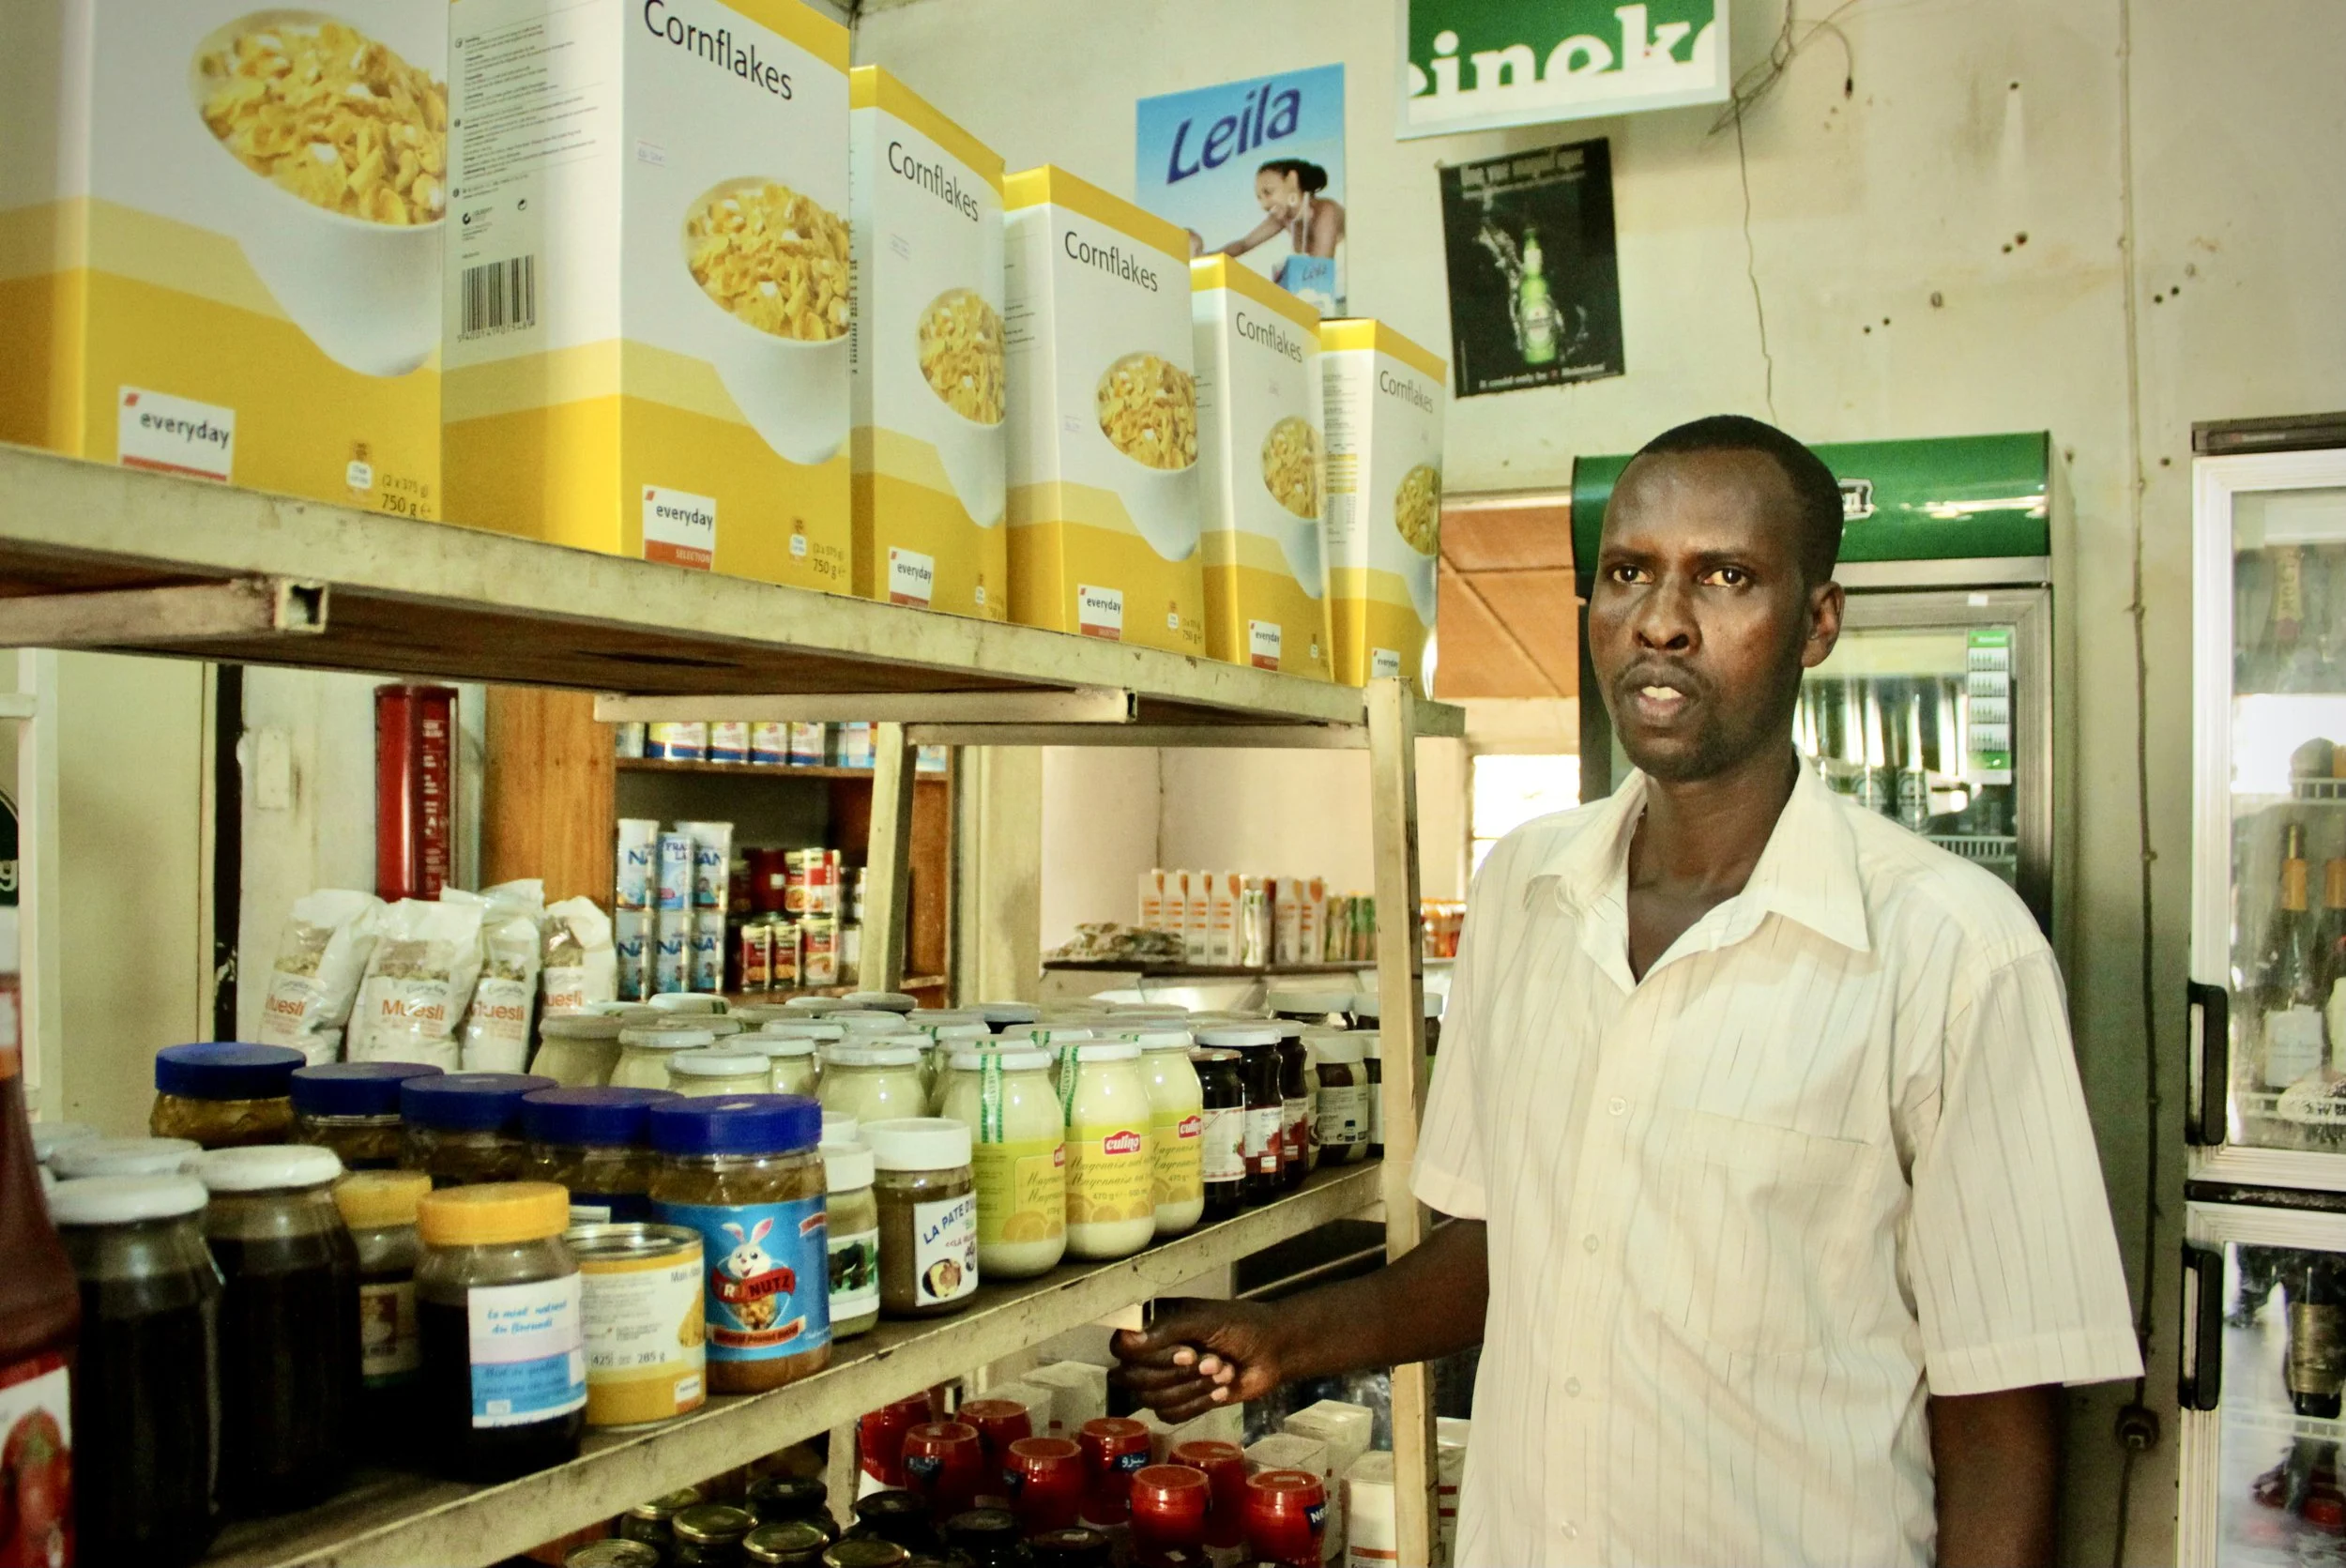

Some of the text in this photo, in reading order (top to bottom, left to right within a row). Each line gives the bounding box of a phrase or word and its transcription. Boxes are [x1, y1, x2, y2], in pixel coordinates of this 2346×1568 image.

[645, 0, 792, 100] Cornflakes
[1166, 83, 1302, 185] Leila
[888, 141, 979, 222] Cornflakes
[1064, 230, 1159, 292] Cornflakes
[1237, 311, 1302, 363] Cornflakes
[1379, 370, 1434, 414] Cornflakes
[140, 410, 231, 450] everyday
[382, 493, 406, 513] 750
[656, 504, 714, 531] everyday
[676, 548, 711, 563] SELECTION
[813, 557, 830, 574] 750
[897, 561, 932, 586] everyday
[1087, 597, 1121, 614] everyday
[1256, 631, 1280, 644] everyday
[1378, 657, 1399, 670] everyday
[381, 998, 445, 1021] Muesli
[543, 990, 583, 1008] uesli
[1104, 1138, 1139, 1153] culino
[1093, 1192, 1108, 1200] 470
[923, 1225, 940, 1245] LA
[941, 1203, 964, 1229] PATE
[638, 1352, 656, 1363] 285
